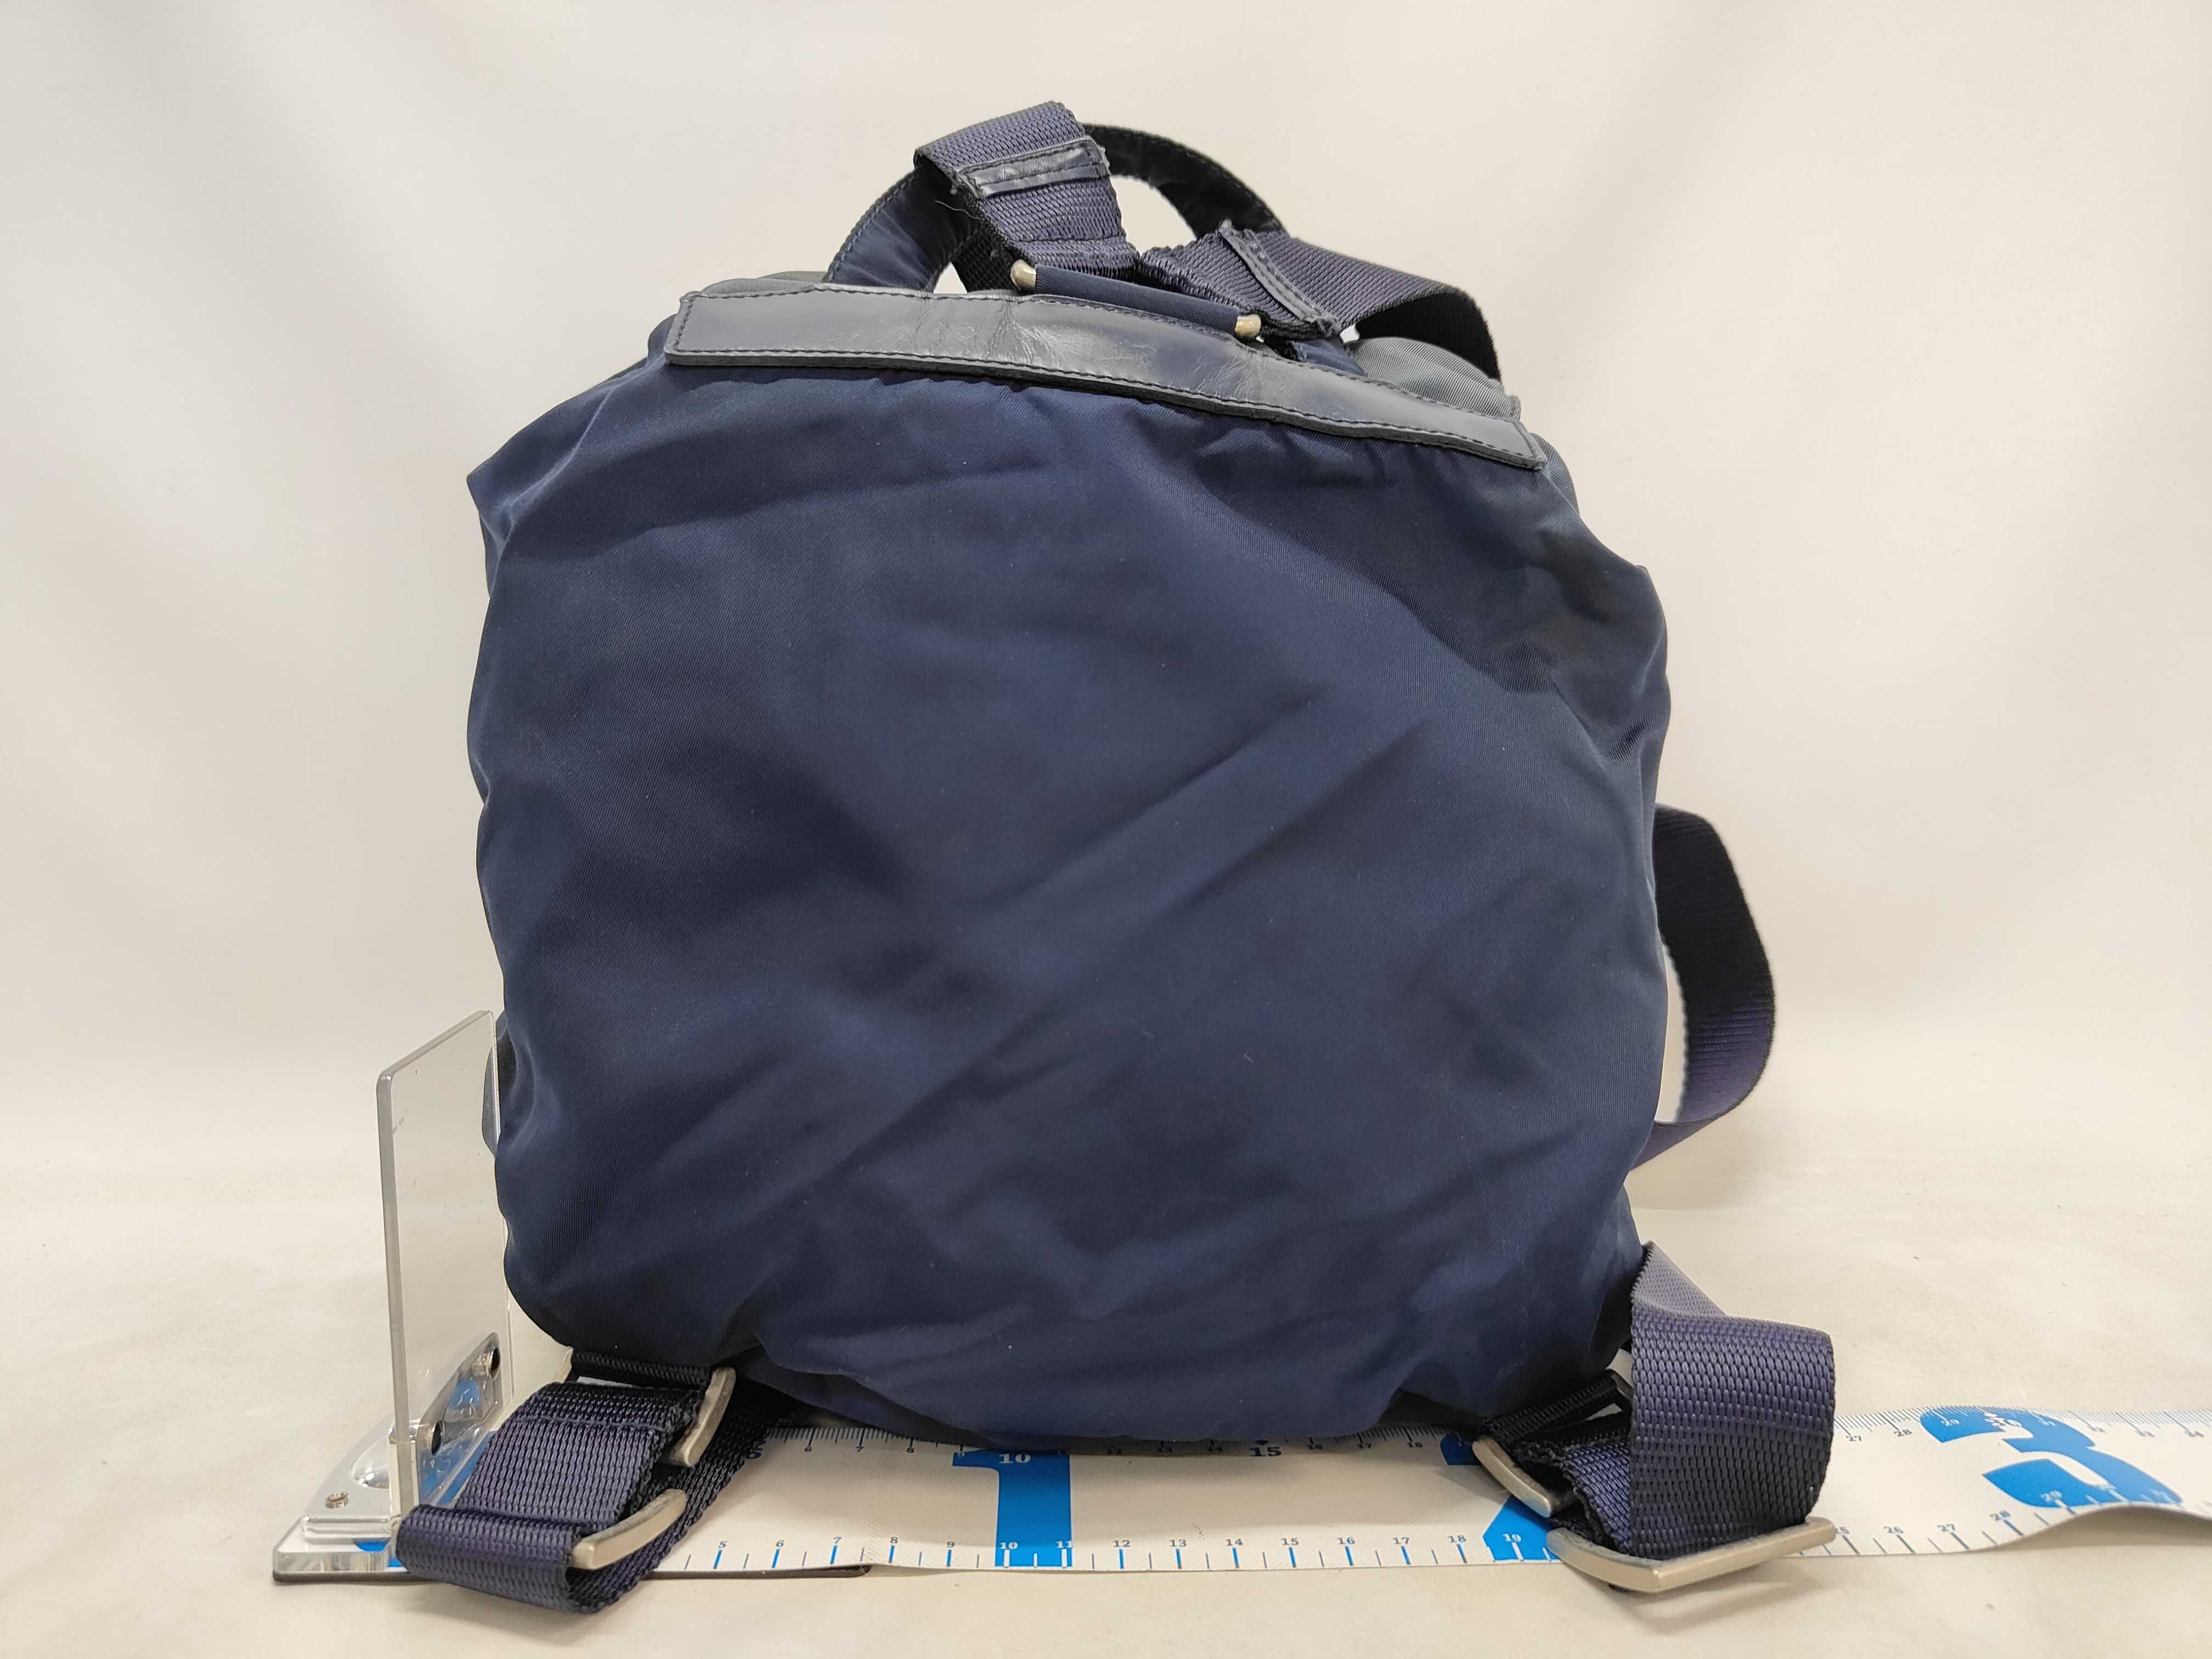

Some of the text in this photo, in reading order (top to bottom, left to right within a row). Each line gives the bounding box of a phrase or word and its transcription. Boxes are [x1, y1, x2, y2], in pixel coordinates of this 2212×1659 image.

[1893, 1429, 1912, 1437] 28
[998, 1453, 1031, 1464] 10
[1249, 1447, 1282, 1457] 15
[1919, 1406, 2184, 1508] 3
[1884, 1525, 1904, 1534] 26
[1938, 1523, 1957, 1532] 27
[1990, 1510, 2011, 1521] 28
[2040, 1491, 2063, 1502] 29
[1000, 1542, 1018, 1550] 10
[1056, 1541, 1074, 1549] 11
[1169, 1539, 1187, 1547] 13
[1503, 1534, 1522, 1543] 19
